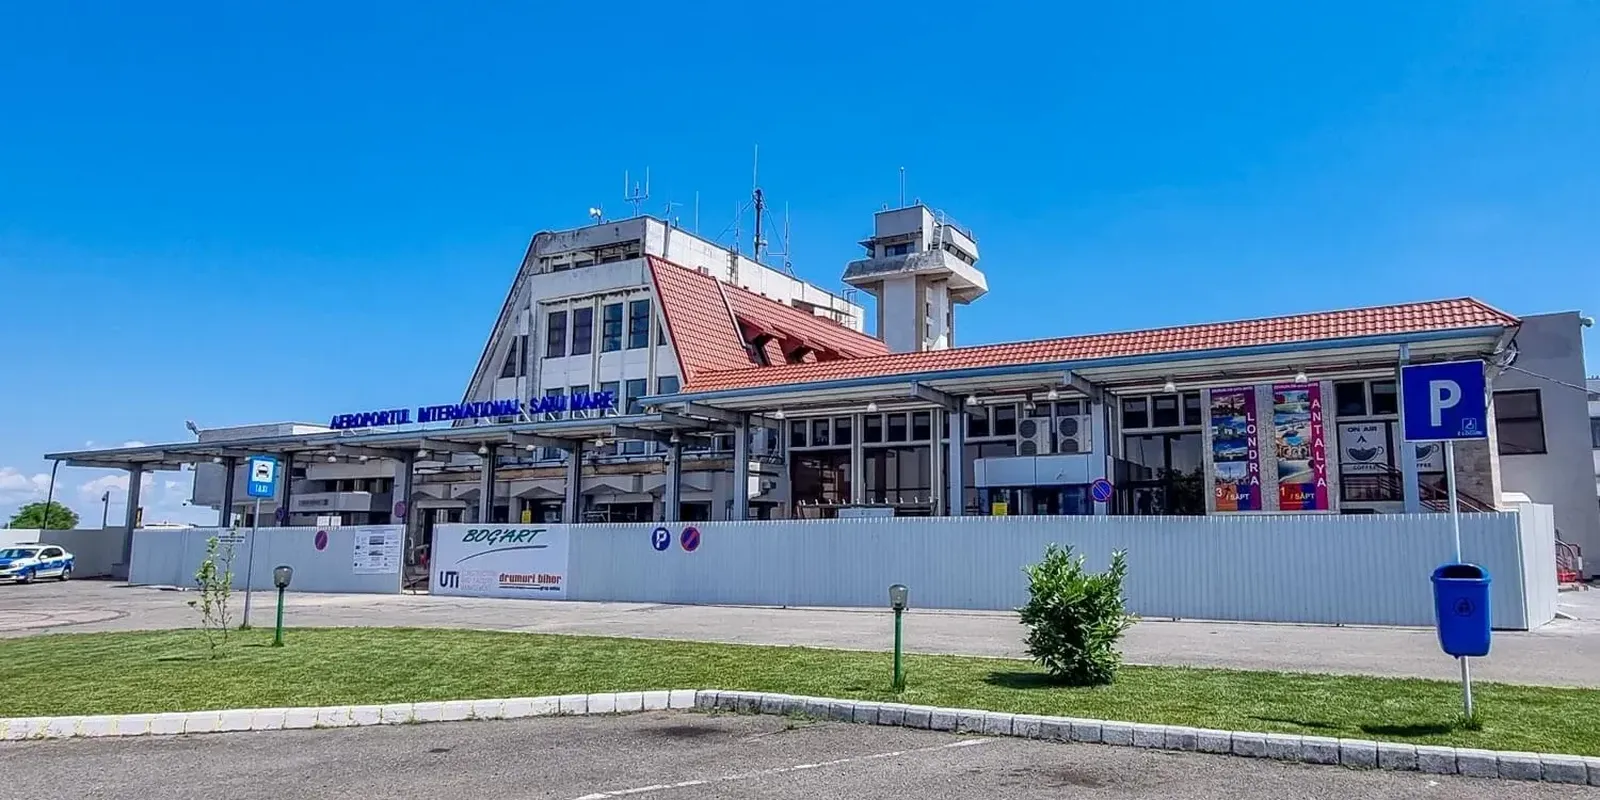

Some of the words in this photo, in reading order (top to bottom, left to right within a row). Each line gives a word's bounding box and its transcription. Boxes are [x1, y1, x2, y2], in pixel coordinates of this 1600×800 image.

[330, 409, 413, 429] AEROPORTUL
[529, 395, 568, 414] SATU
[570, 391, 614, 411] MARE
[1429, 380, 1461, 426] P
[1247, 412, 1260, 486] LONDRA
[1311, 399, 1327, 488] ANTALYA
[255, 484, 269, 493] TAXI
[1215, 487, 1223, 498] 3
[1280, 486, 1285, 497] 1
[656, 530, 667, 549] P
[499, 573, 536, 583] drumuri
[537, 574, 562, 584] bihor
